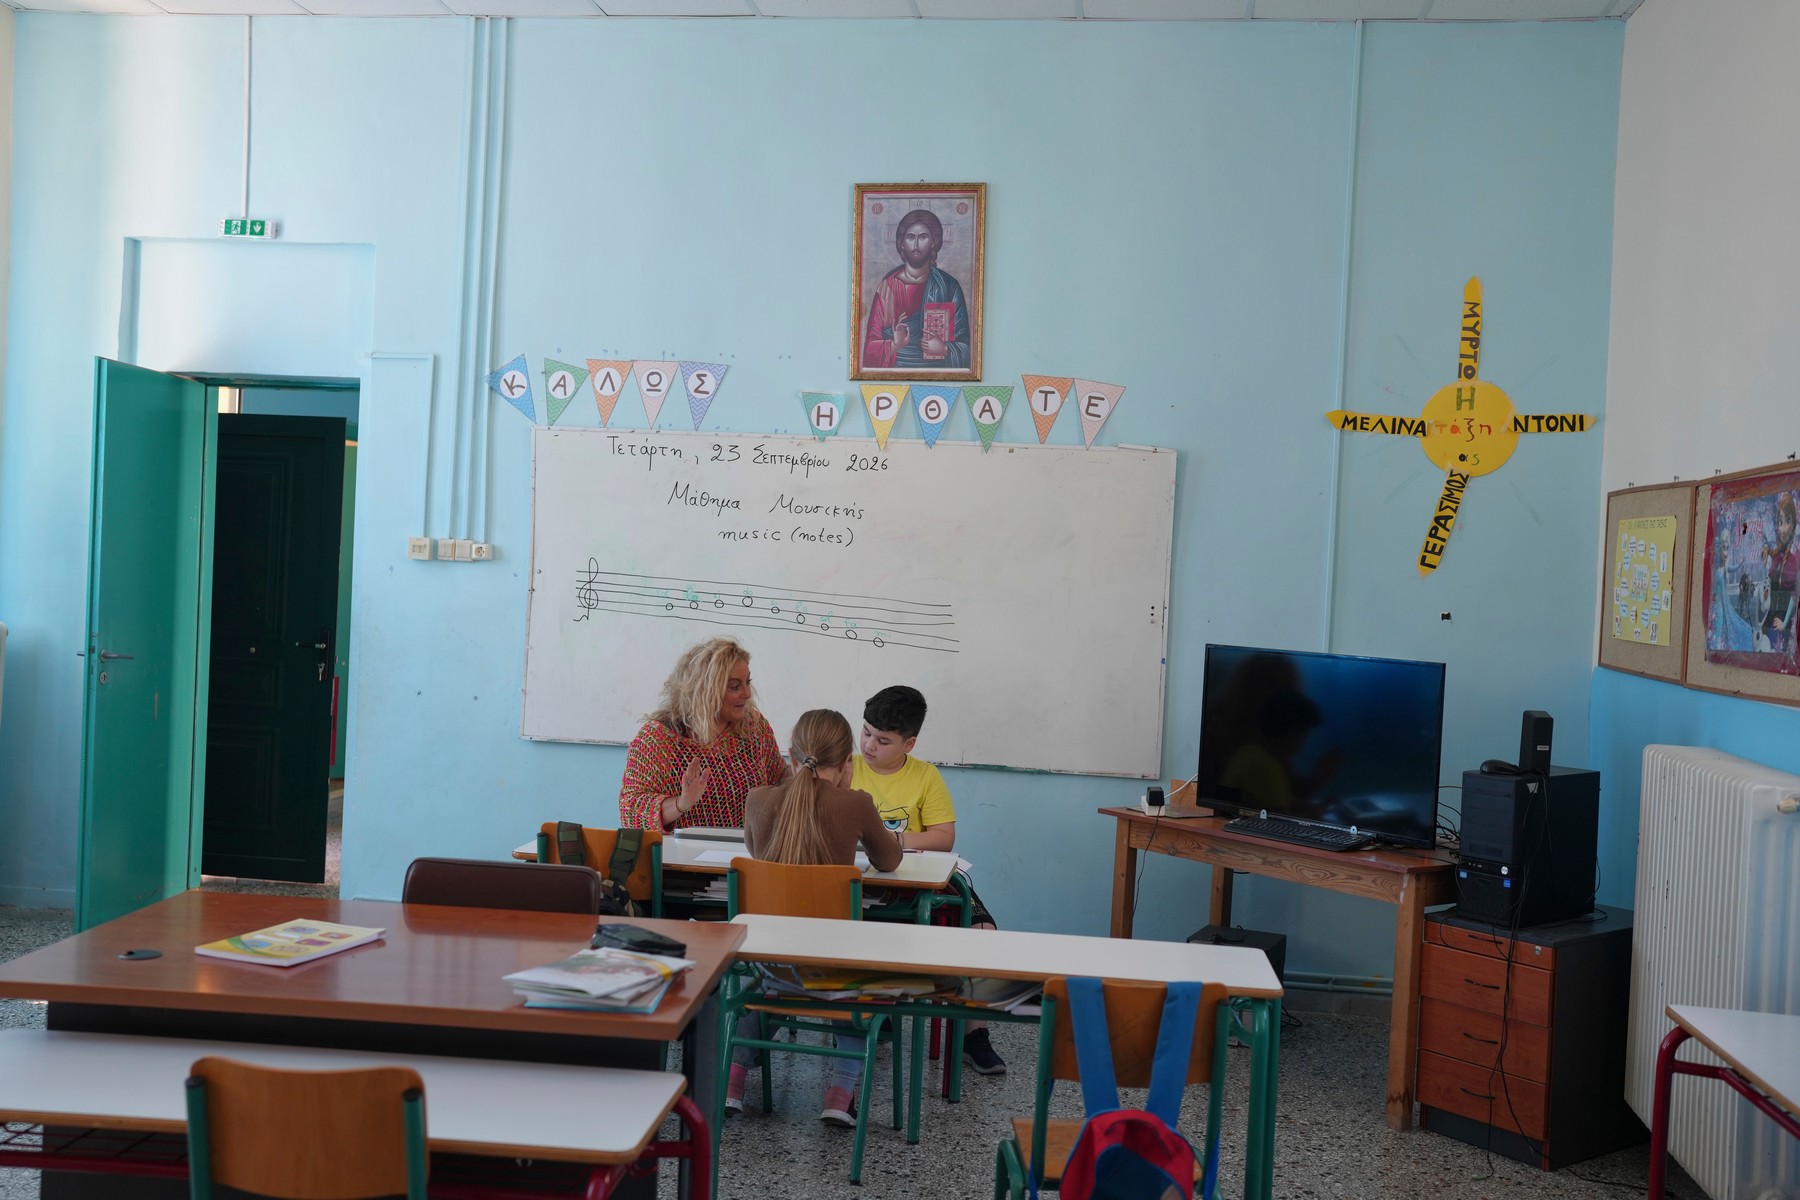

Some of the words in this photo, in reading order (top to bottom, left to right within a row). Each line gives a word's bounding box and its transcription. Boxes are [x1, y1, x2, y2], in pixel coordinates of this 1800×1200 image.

[1457, 301, 1481, 380] ΜΥΡΤΩ
[503, 371, 710, 397] ΚΑΛΩΣ
[816, 390, 1106, 427] ΗΡΘΑΤΕ
[1456, 386, 1475, 411] Η
[1340, 414, 1428, 437] ΜΕΛΙΝΑ
[1435, 418, 1492, 442] τάξη
[1513, 414, 1585, 432] ΝΤΟΝΙ
[710, 443, 741, 462] 23
[752, 443, 830, 478] Σεπτεμβρίου
[845, 454, 889, 472] 2026
[667, 481, 741, 516] Μάθημα
[769, 494, 865, 520] Μουσικής
[1419, 468, 1470, 569] ΓΕΡΑΣΙΜΟΣ
[718, 529, 781, 541] music
[791, 526, 854, 547] (notes)
